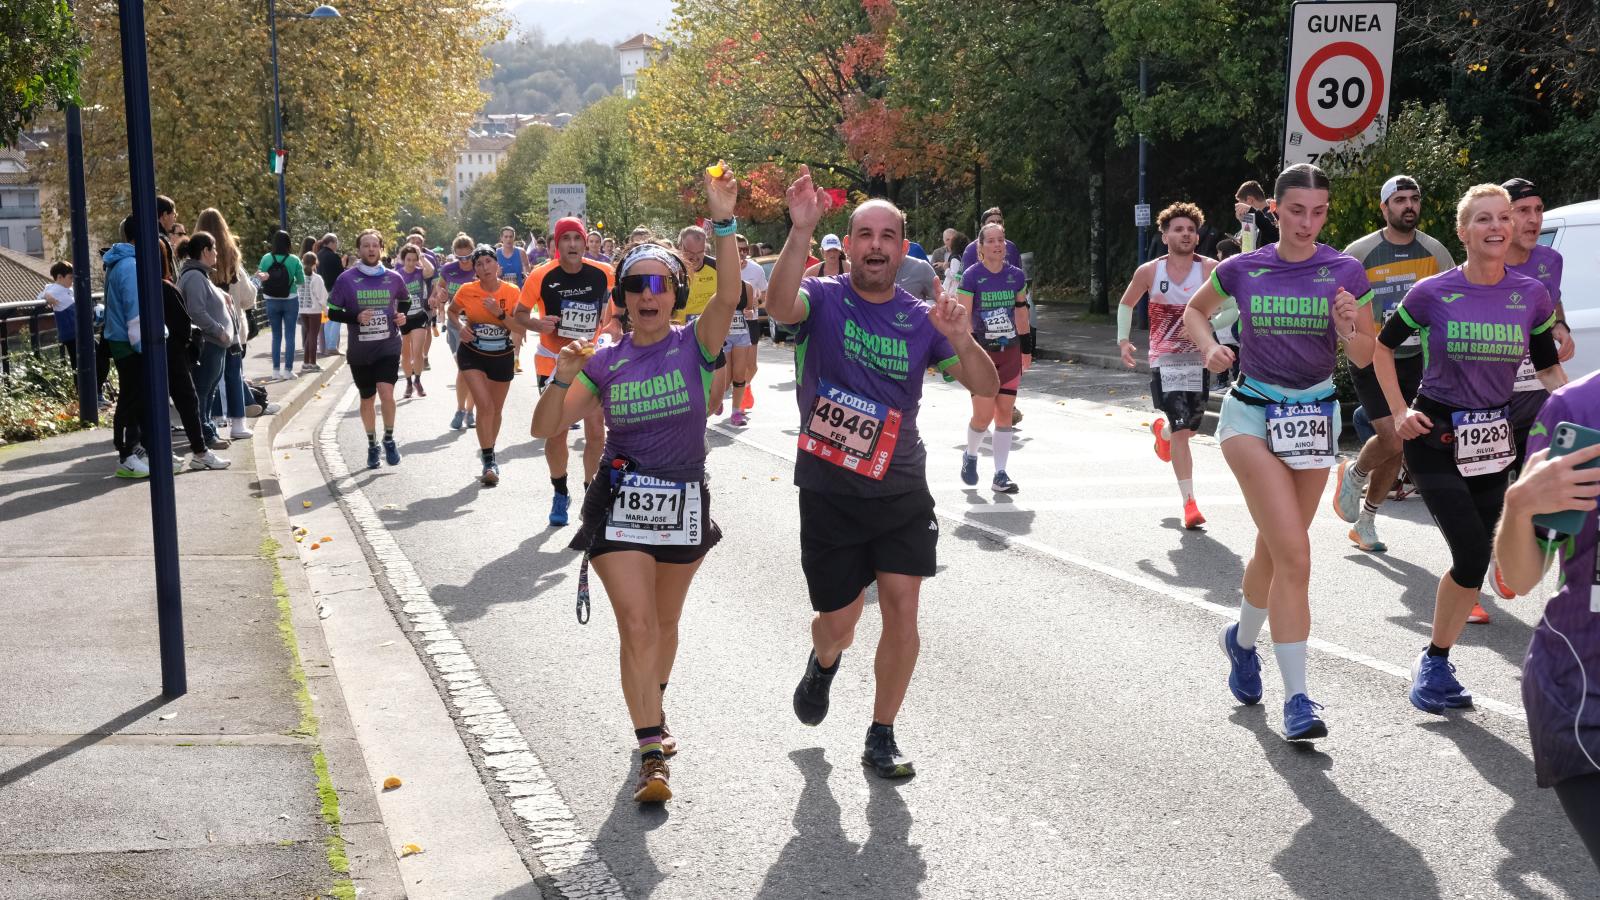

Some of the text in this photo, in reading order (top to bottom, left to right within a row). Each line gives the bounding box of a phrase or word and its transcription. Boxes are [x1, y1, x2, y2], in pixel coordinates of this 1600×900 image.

[1307, 14, 1382, 33] GUNEA
[1317, 76, 1365, 109] 30
[356, 289, 391, 299] BEHOBIA
[558, 286, 593, 296] TRIALS
[981, 290, 1015, 302] BEHOBIA
[1250, 295, 1329, 316] BEHOBIA
[564, 311, 597, 323] 17197
[1251, 315, 1329, 329] SAN SEBASTIÁN
[844, 319, 909, 359] BEHOBIA
[1447, 320, 1524, 343] BEHOBIA
[844, 338, 862, 355] SAN
[1446, 341, 1525, 356] SAN SEBASTIÁN
[610, 368, 687, 402] BEHOBIA
[610, 389, 690, 416] SAN SEBASTIÁN
[815, 402, 876, 440] 4946
[1272, 419, 1327, 440] 19284
[830, 431, 847, 444] FER
[1460, 423, 1509, 446] 19283
[1475, 447, 1495, 455] SILVIA
[872, 450, 889, 478] 4946
[615, 490, 678, 512] 18371
[625, 513, 649, 522] MARIA
[689, 510, 698, 544] 18371
